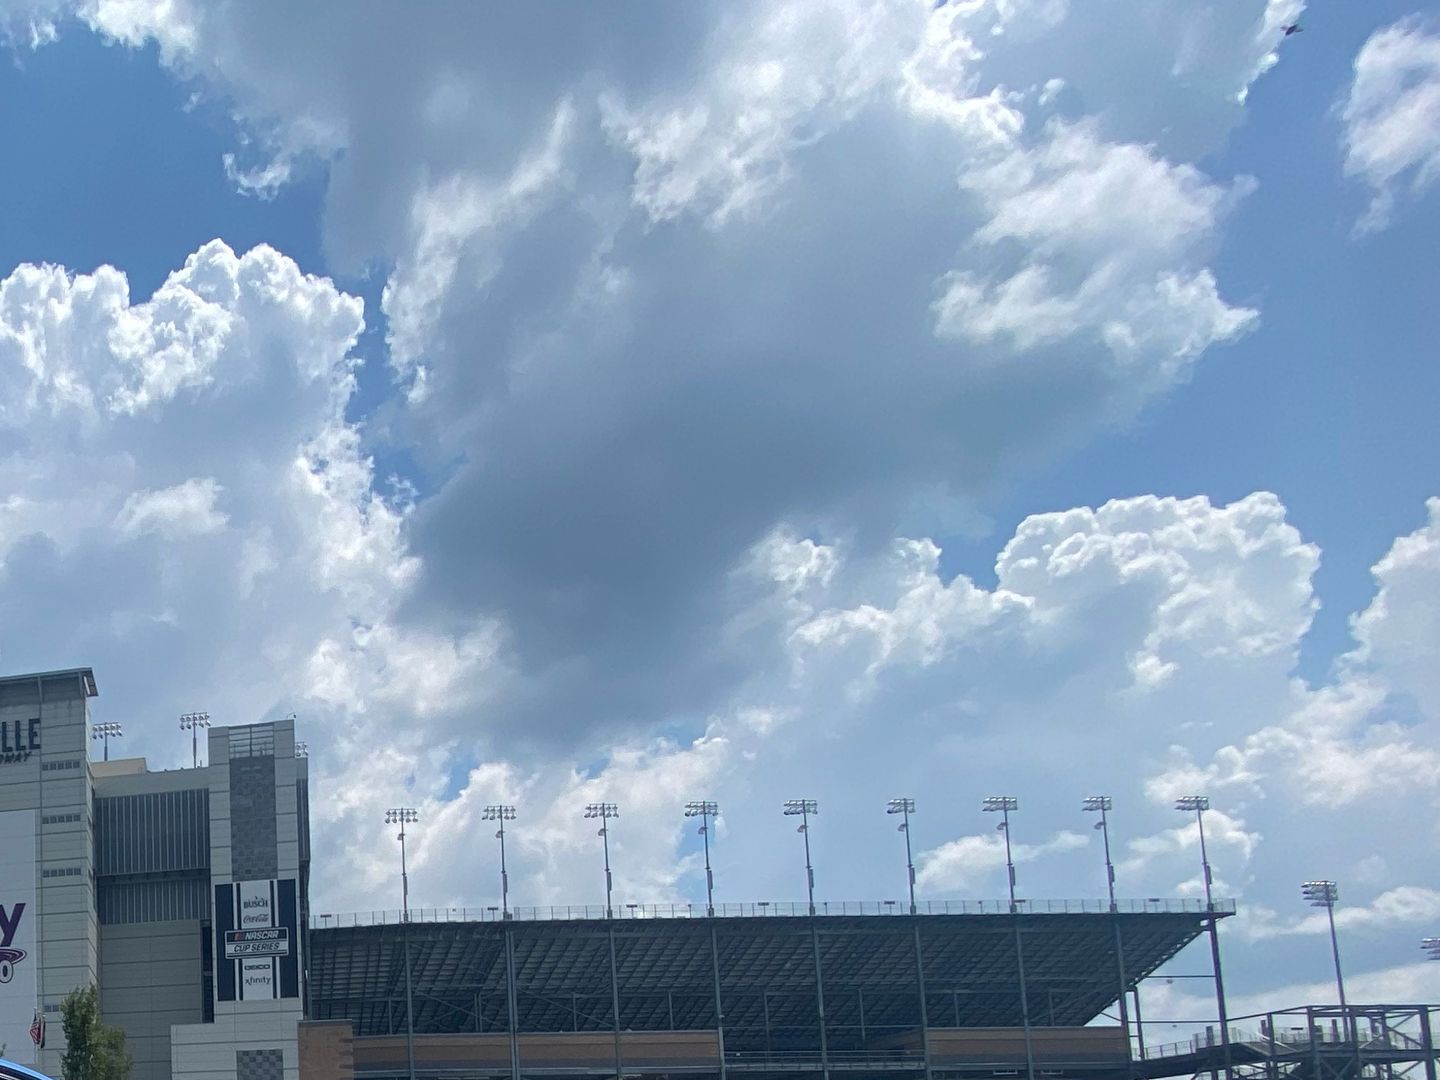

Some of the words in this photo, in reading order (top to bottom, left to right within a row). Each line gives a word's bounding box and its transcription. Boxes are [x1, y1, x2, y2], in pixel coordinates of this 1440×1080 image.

[244, 930, 279, 941] NASCAR
[233, 944, 250, 953] CUP
[251, 942, 280, 952] SERIES
[244, 963, 271, 971] GEICO
[245, 976, 271, 986] xfinity
